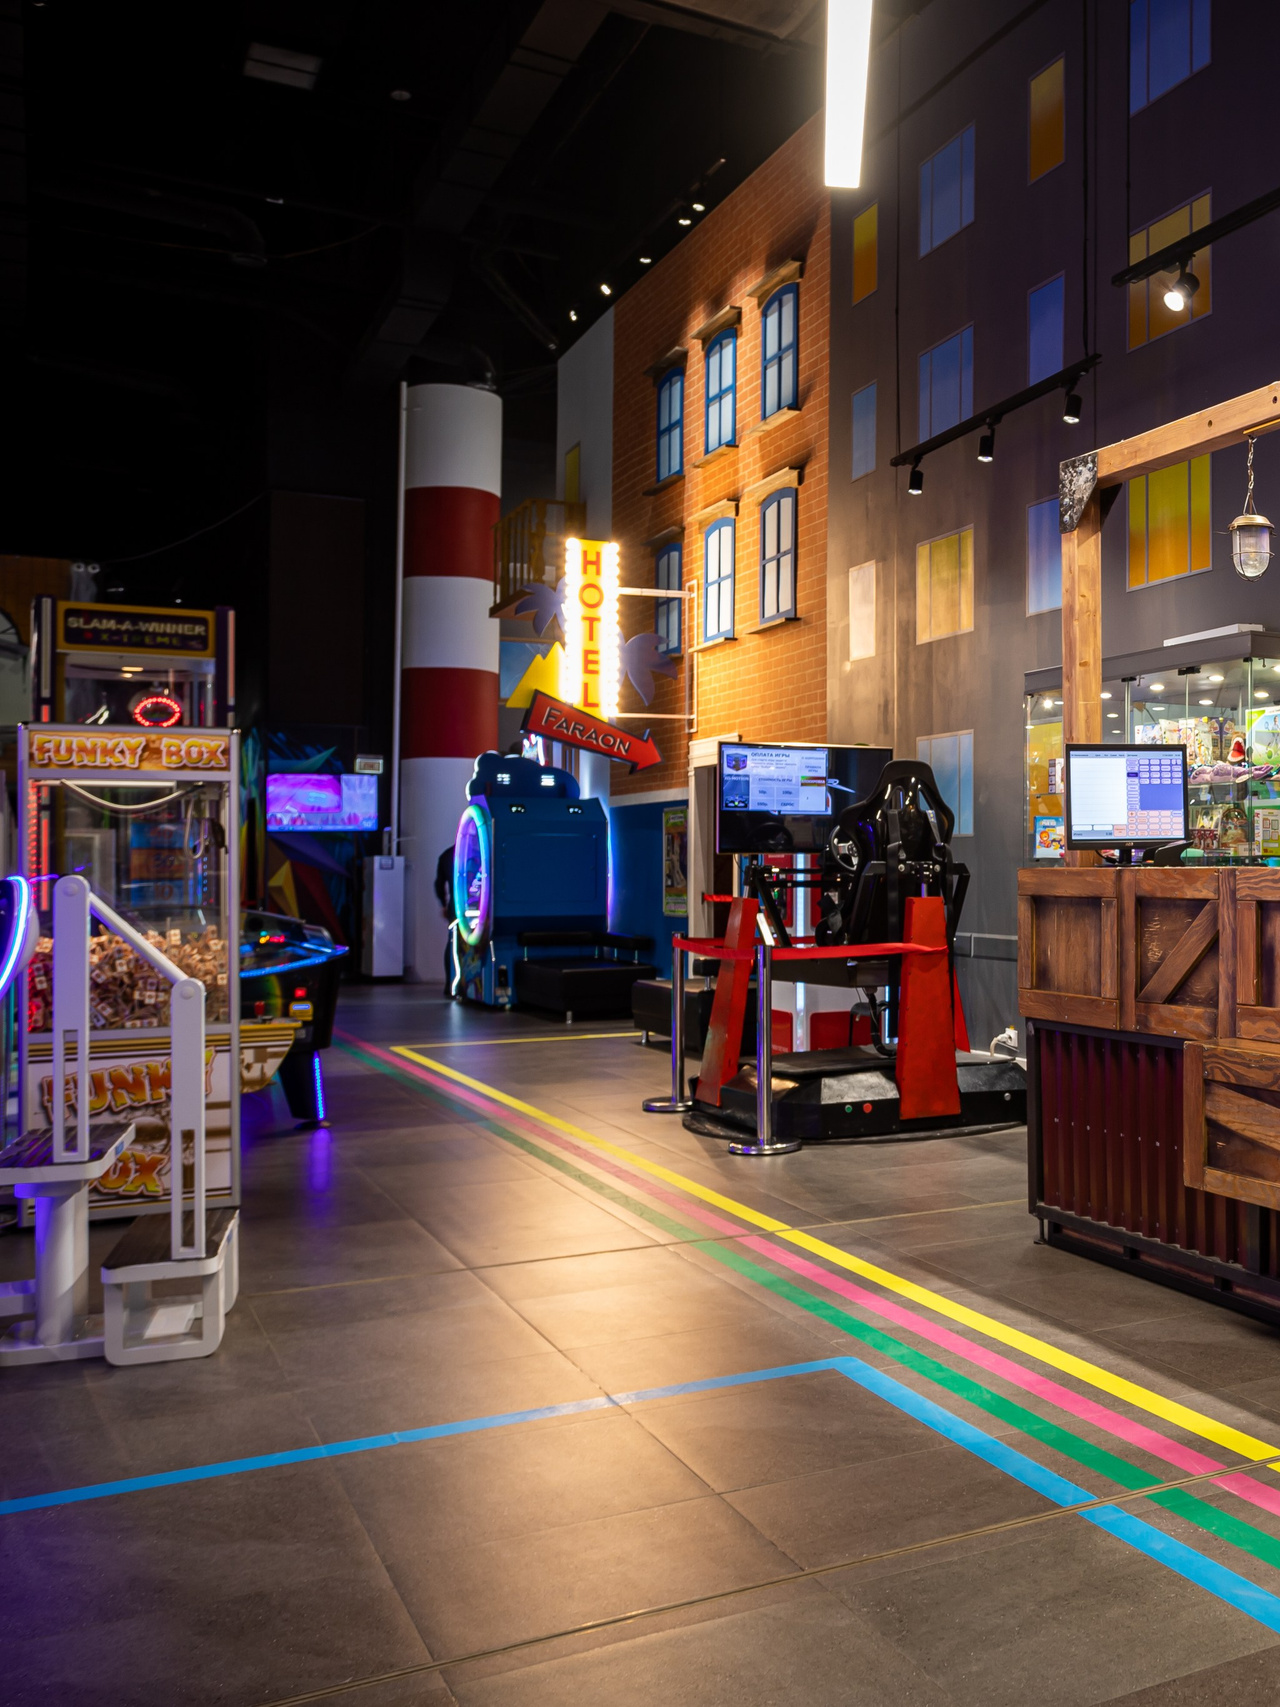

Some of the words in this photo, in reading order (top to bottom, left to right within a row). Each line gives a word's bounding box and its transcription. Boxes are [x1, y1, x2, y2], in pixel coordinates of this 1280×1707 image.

[67, 616, 206, 636] SLAM-A-WINNER
[578, 550, 605, 708] HOTEL
[33, 735, 146, 768] FUNKY
[162, 738, 226, 768] BOX
[541, 706, 632, 756] FARAON
[43, 1048, 215, 1113] FUNK
